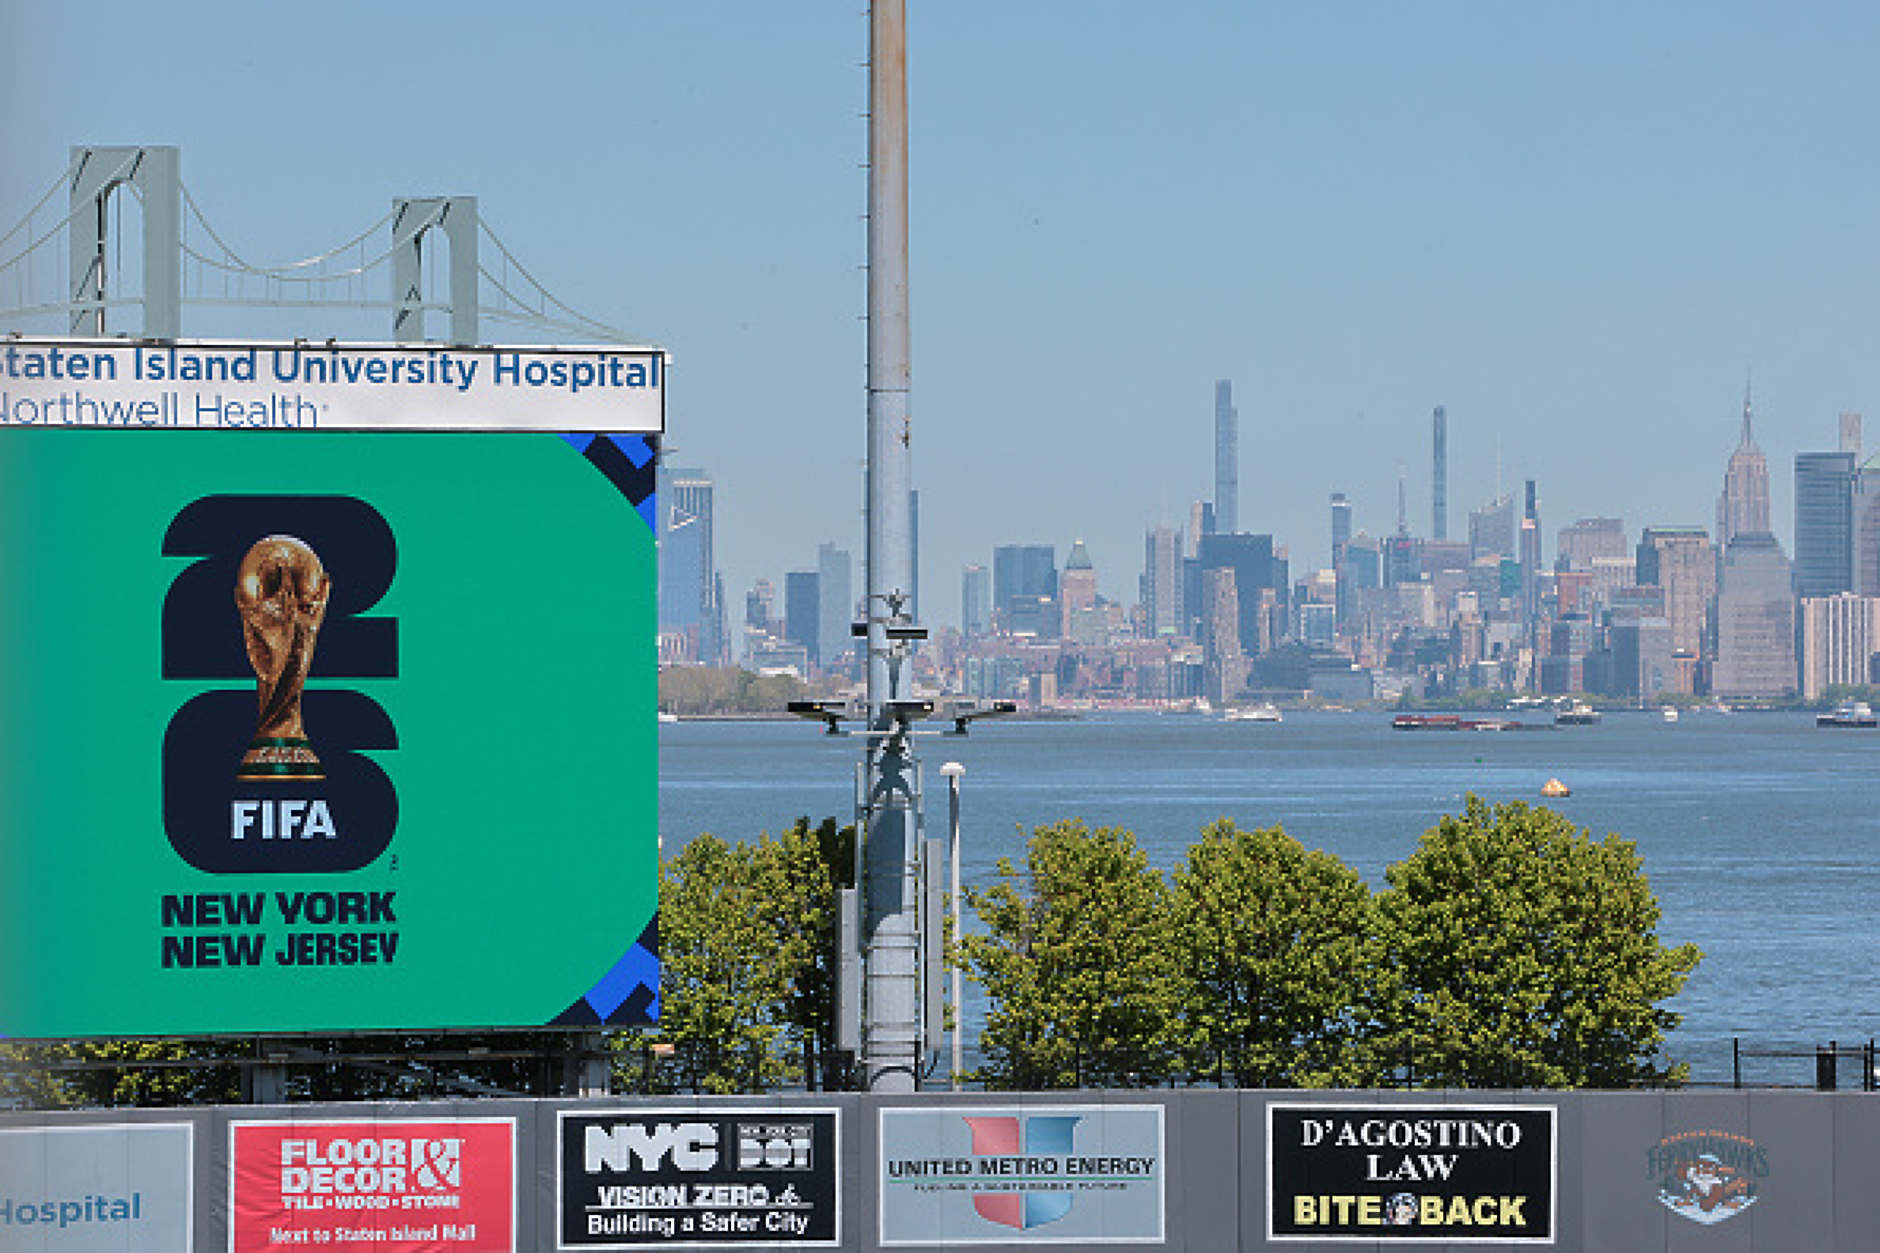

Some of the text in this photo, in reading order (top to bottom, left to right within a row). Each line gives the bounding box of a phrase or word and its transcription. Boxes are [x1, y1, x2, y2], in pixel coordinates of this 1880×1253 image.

[0, 347, 659, 392] taten Island University Hospital
[196, 391, 318, 427] Health
[231, 800, 337, 839] FIFA
[161, 892, 397, 928] NEW YORK
[161, 933, 400, 968] NEW JERSEY
[585, 1123, 719, 1172] NYC
[1300, 1119, 1523, 1149] D'AGOSTINO
[281, 1139, 406, 1165] FLOOR
[888, 1157, 1155, 1176] UNITED METRO ENERGY
[281, 1167, 406, 1194] DECOR
[1366, 1154, 1459, 1181] LAW
[598, 1184, 769, 1206] VISION ZERO
[587, 1211, 808, 1237] Building a Safer City
[1293, 1195, 1527, 1226] BITE BACK
[271, 1224, 476, 1244] Next to Staten Island Mall
